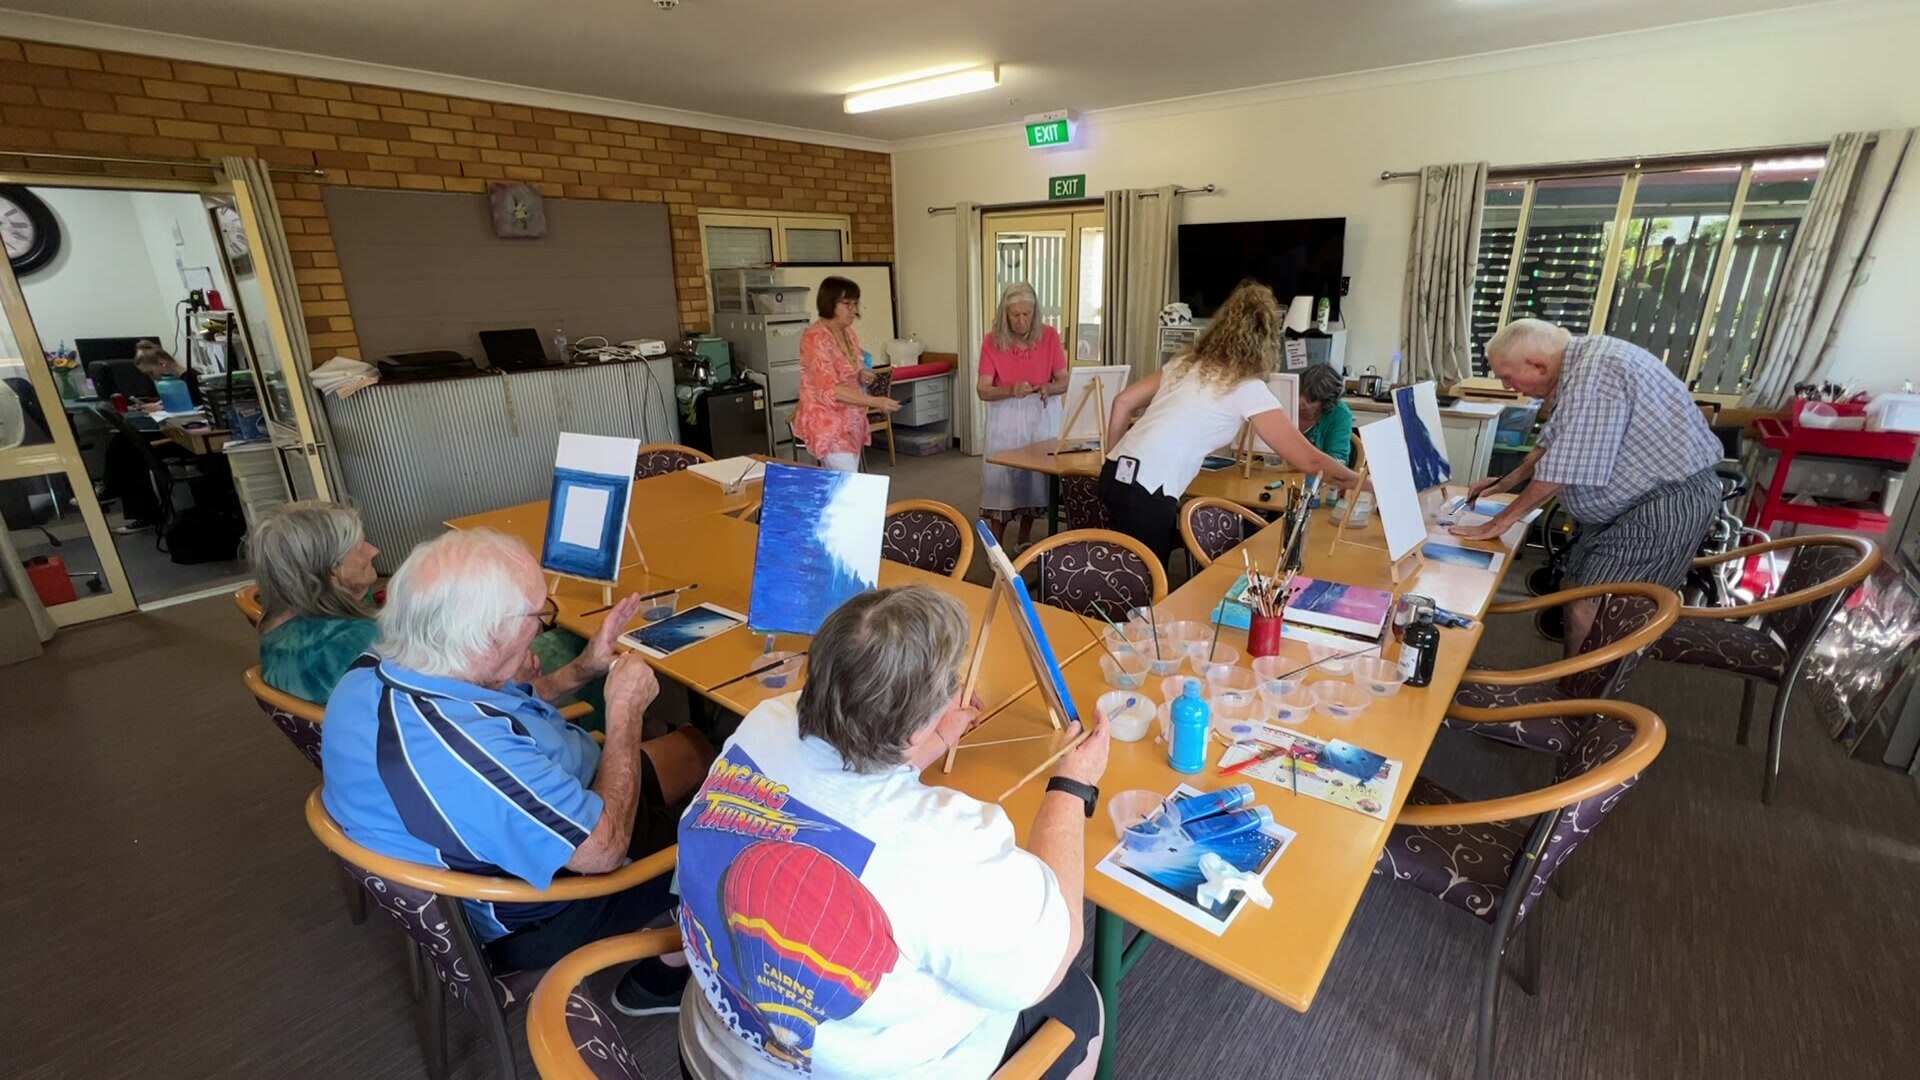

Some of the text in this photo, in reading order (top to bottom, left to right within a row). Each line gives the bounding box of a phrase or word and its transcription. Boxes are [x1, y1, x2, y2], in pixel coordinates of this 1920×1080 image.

[1033, 123, 1059, 144] EXIT
[1055, 178, 1079, 196] EXIT
[695, 792, 800, 842] THUNDER
[763, 962, 815, 1001] CAIRNS
